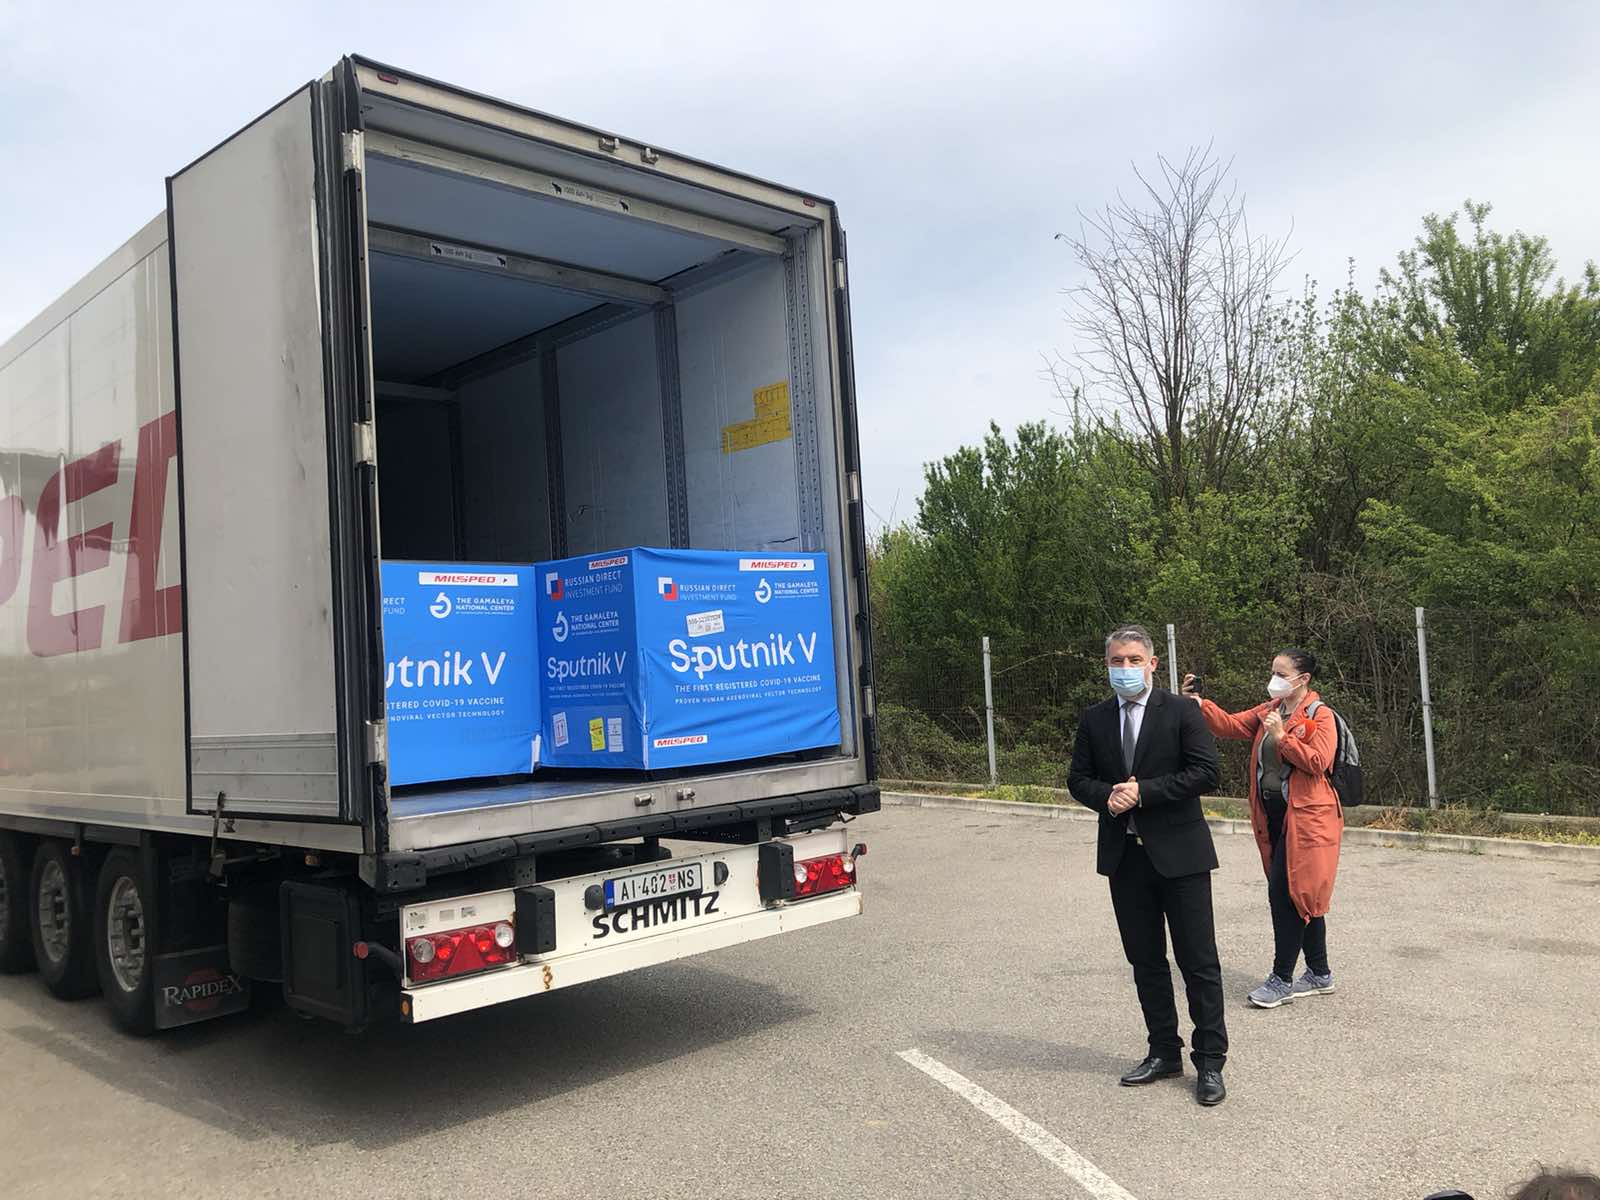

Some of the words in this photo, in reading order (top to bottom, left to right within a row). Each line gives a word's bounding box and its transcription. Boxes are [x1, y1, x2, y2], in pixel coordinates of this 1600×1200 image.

[750, 561, 798, 569] MILSPED
[434, 575, 497, 584] MILSPED
[565, 575, 595, 586] RUSSIAN
[597, 570, 621, 582] DIRECT
[605, 583, 623, 593] FUND
[680, 584, 711, 592] RUSSIAN
[712, 584, 736, 592] DIRECT
[473, 597, 515, 605] GAMALEYA
[571, 623, 597, 631] NATIONAL
[598, 619, 619, 628] CENTER
[668, 632, 796, 680] Sputnik
[797, 631, 817, 664] V
[480, 651, 507, 685] V
[547, 651, 612, 683] Sputnik
[614, 650, 627, 675] V
[675, 684, 693, 693] THE
[693, 683, 715, 692] FIRST
[715, 679, 758, 690] REGISTERED
[793, 673, 821, 683] VACCINE
[422, 698, 465, 708] COVID-19
[467, 697, 505, 705] VACCINE
[426, 711, 455, 720] VECTOR
[677, 868, 695, 890] NS
[592, 890, 720, 940] SCHMITZ
[161, 975, 243, 1006] RAPIDEX
